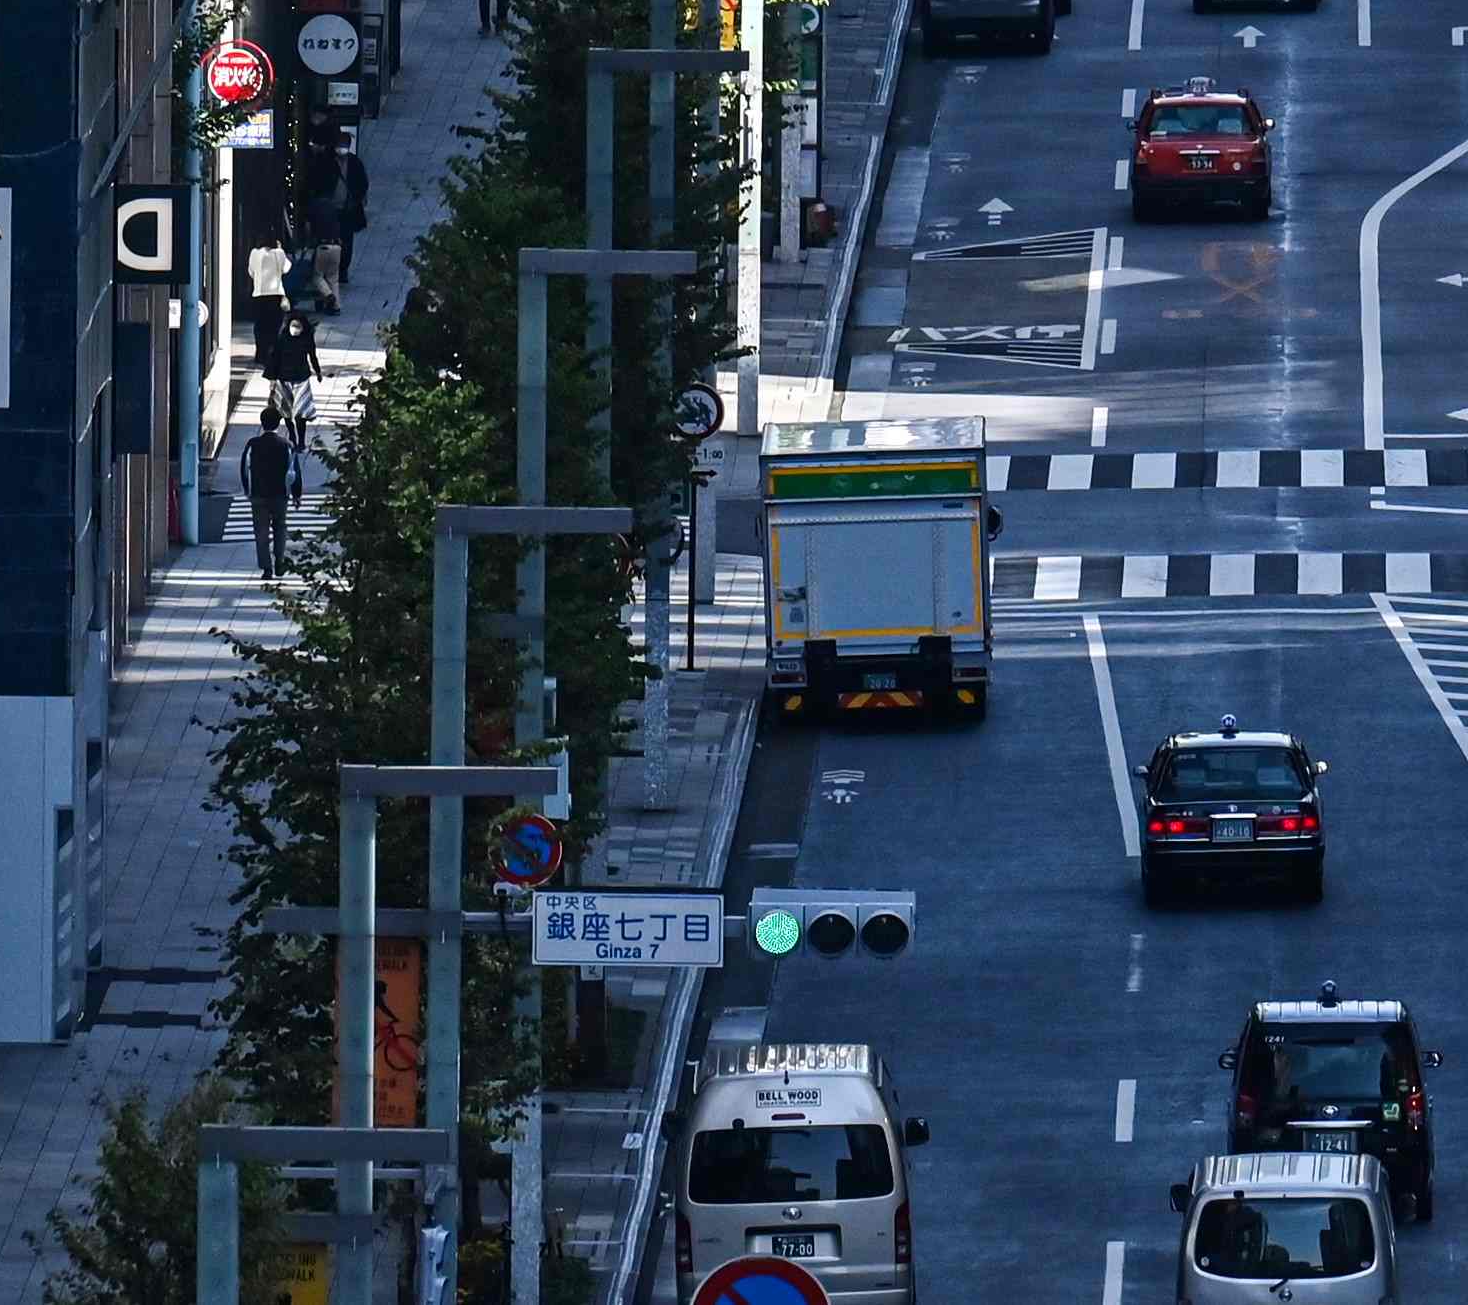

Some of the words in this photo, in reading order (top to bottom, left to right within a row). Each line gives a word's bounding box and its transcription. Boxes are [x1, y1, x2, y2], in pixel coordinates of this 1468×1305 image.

[545, 893, 598, 910] 中央区
[545, 912, 712, 943] 銀座七丁目
[594, 941, 642, 961] Ginza
[648, 942, 659, 959] 7
[758, 1090, 784, 1101] BELL
[788, 1090, 819, 1101] WOOD
